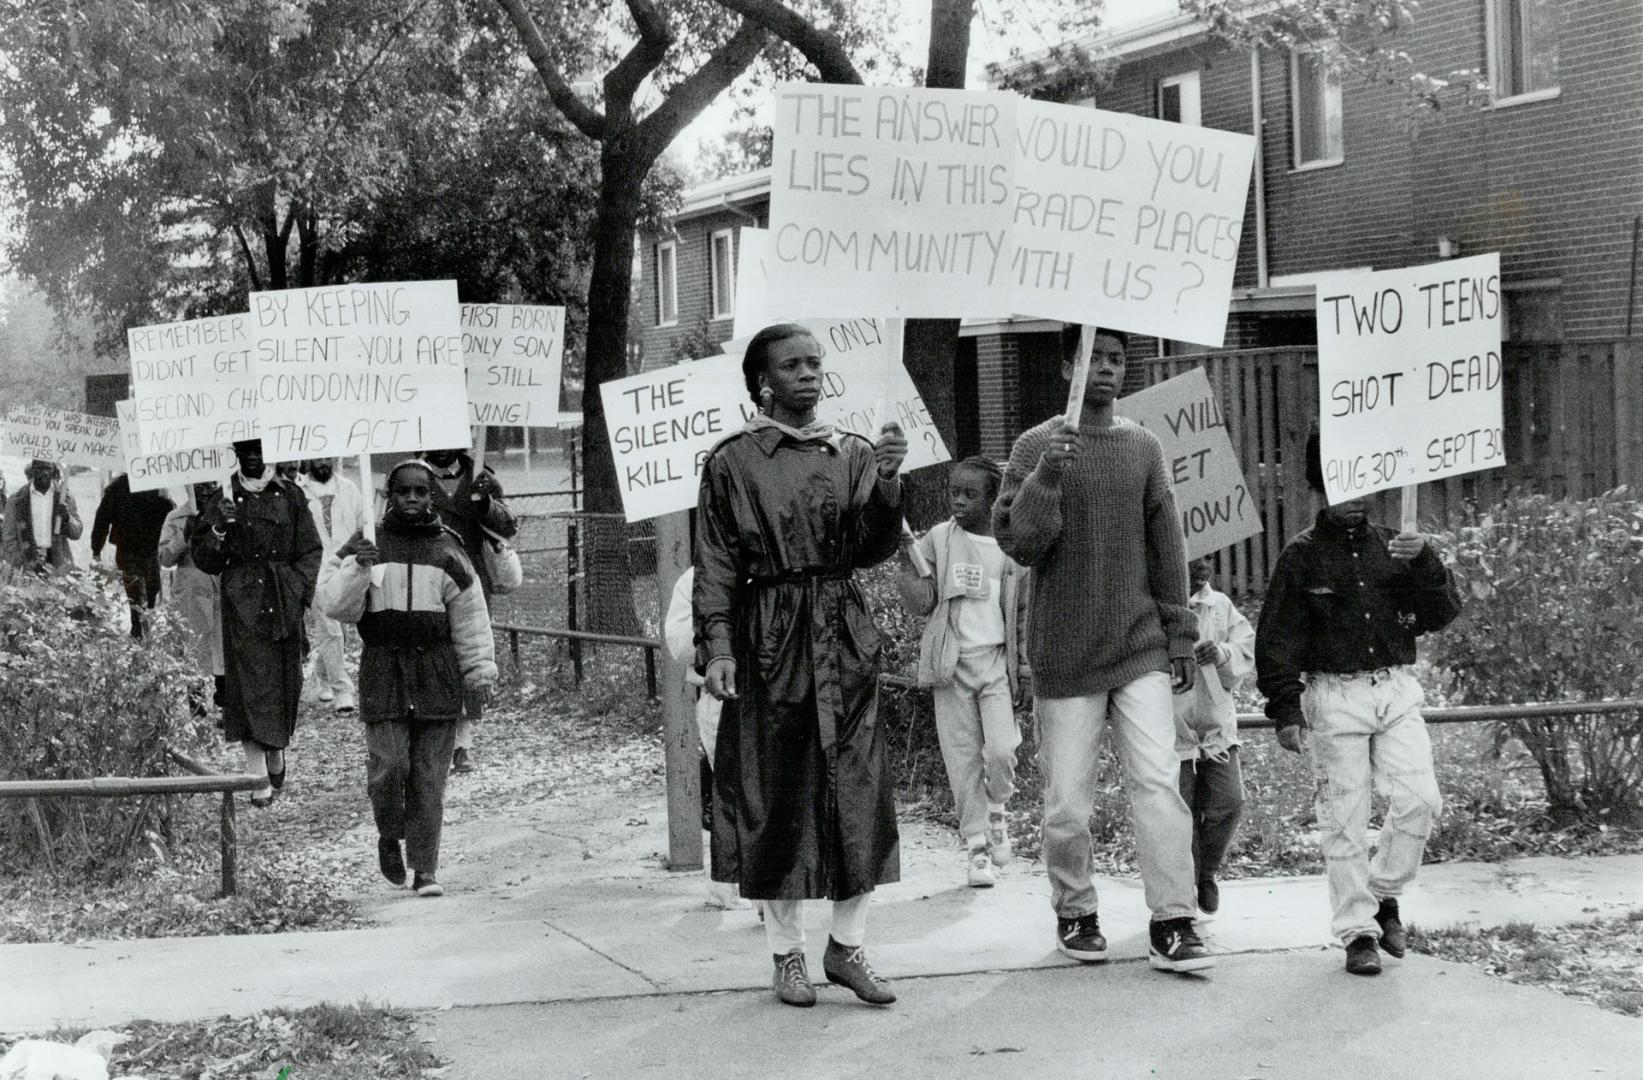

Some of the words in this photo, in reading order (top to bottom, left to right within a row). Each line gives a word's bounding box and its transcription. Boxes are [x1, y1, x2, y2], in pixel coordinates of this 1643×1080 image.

[782, 94, 861, 138] THE
[876, 95, 1000, 148] ANSWER
[788, 149, 870, 196] LIES
[891, 157, 928, 203] IN
[938, 164, 1008, 205] THIS
[1147, 140, 1224, 201] YOU
[1134, 204, 1242, 262] PLACES
[776, 222, 1006, 286] COMMUNITY
[256, 293, 289, 328] BY
[304, 287, 411, 327] KEEPING
[460, 305, 501, 328] FIRST
[511, 306, 558, 334] BORN
[1323, 288, 1403, 336] TWO
[1418, 275, 1499, 329] TEENS
[131, 317, 247, 353] REMEMBER
[257, 336, 345, 363] SILENT
[359, 336, 403, 366] YOU
[416, 335, 462, 366] ARE
[461, 333, 503, 357] ONLY
[513, 335, 554, 359] SON
[829, 318, 882, 353] ONLY
[213, 350, 251, 374] GET
[487, 365, 543, 387] STILL
[260, 372, 418, 404] CONDONING
[622, 379, 686, 415] THE
[1332, 372, 1403, 417] SHOT
[1427, 351, 1501, 400] DEAD
[138, 392, 215, 422] SECOND
[1163, 397, 1225, 438] WILL
[9, 433, 51, 448] WOULD
[56, 440, 77, 453] YOU
[82, 442, 119, 458] MAKE
[44, 420, 60, 431] YOU
[64, 424, 91, 437] SPEAK
[150, 427, 193, 452] NOT
[269, 424, 328, 452] THIS
[614, 408, 723, 455] SILENCE
[626, 458, 683, 492] KILL
[1326, 455, 1367, 494] AUG
[1427, 429, 1481, 473] SEPT
